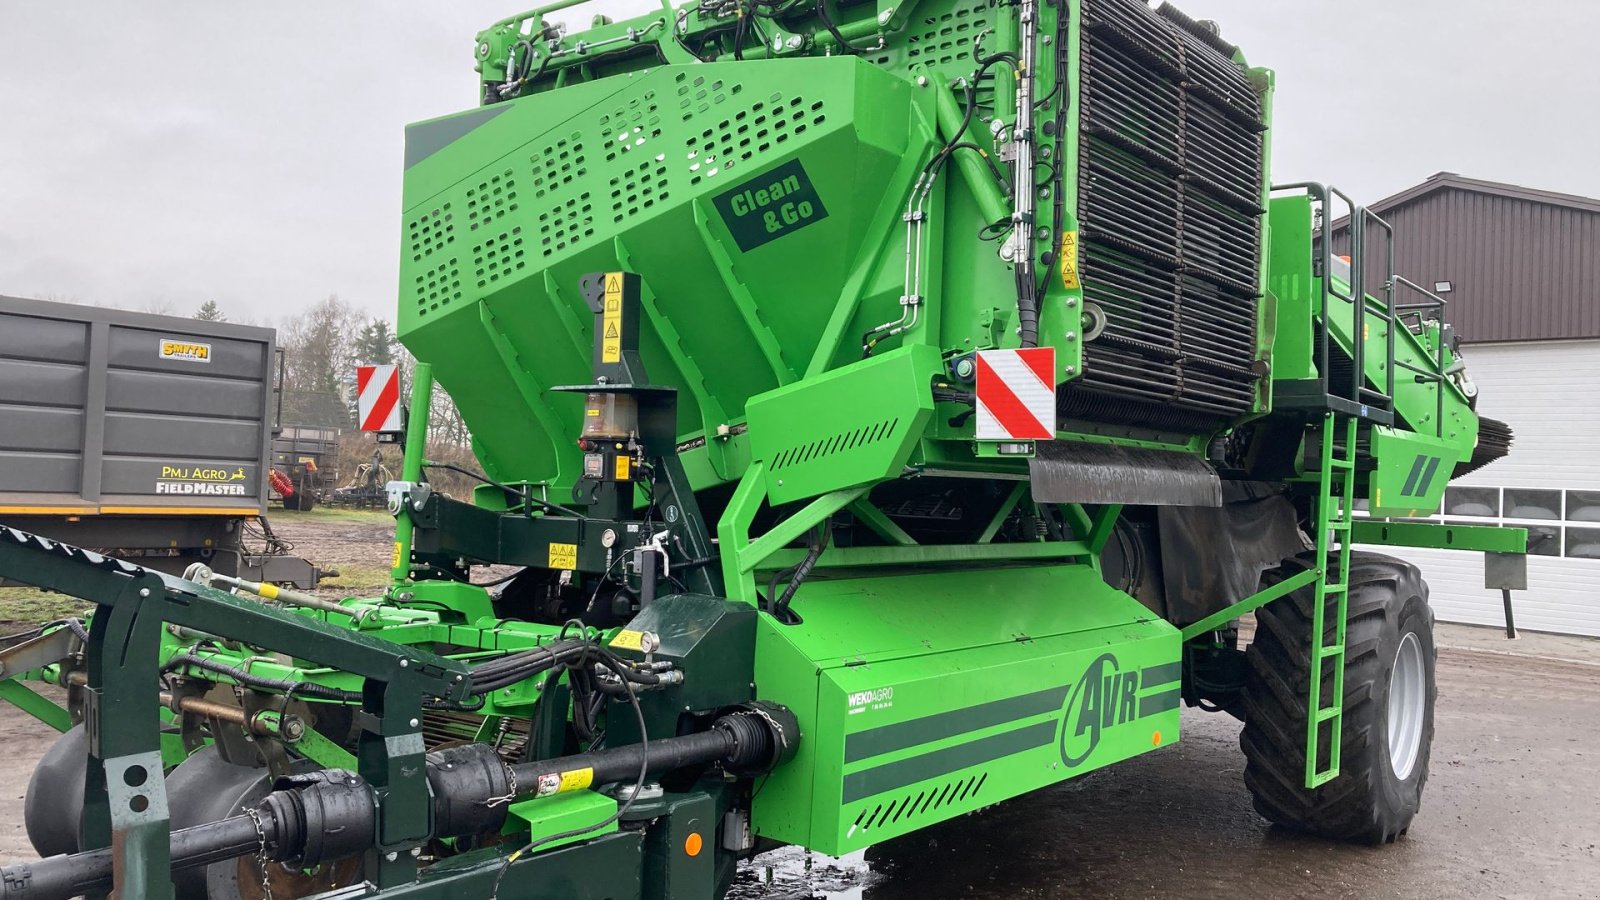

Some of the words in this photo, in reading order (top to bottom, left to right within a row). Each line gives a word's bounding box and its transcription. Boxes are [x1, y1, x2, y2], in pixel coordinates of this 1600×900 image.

[730, 174, 801, 217] Clean
[763, 210, 784, 233] &
[780, 201, 813, 225] Go
[163, 342, 208, 359] SMYTH
[192, 467, 227, 480] AGRO
[848, 686, 894, 707] WEKOAGRO
[1060, 653, 1139, 768] AVR
